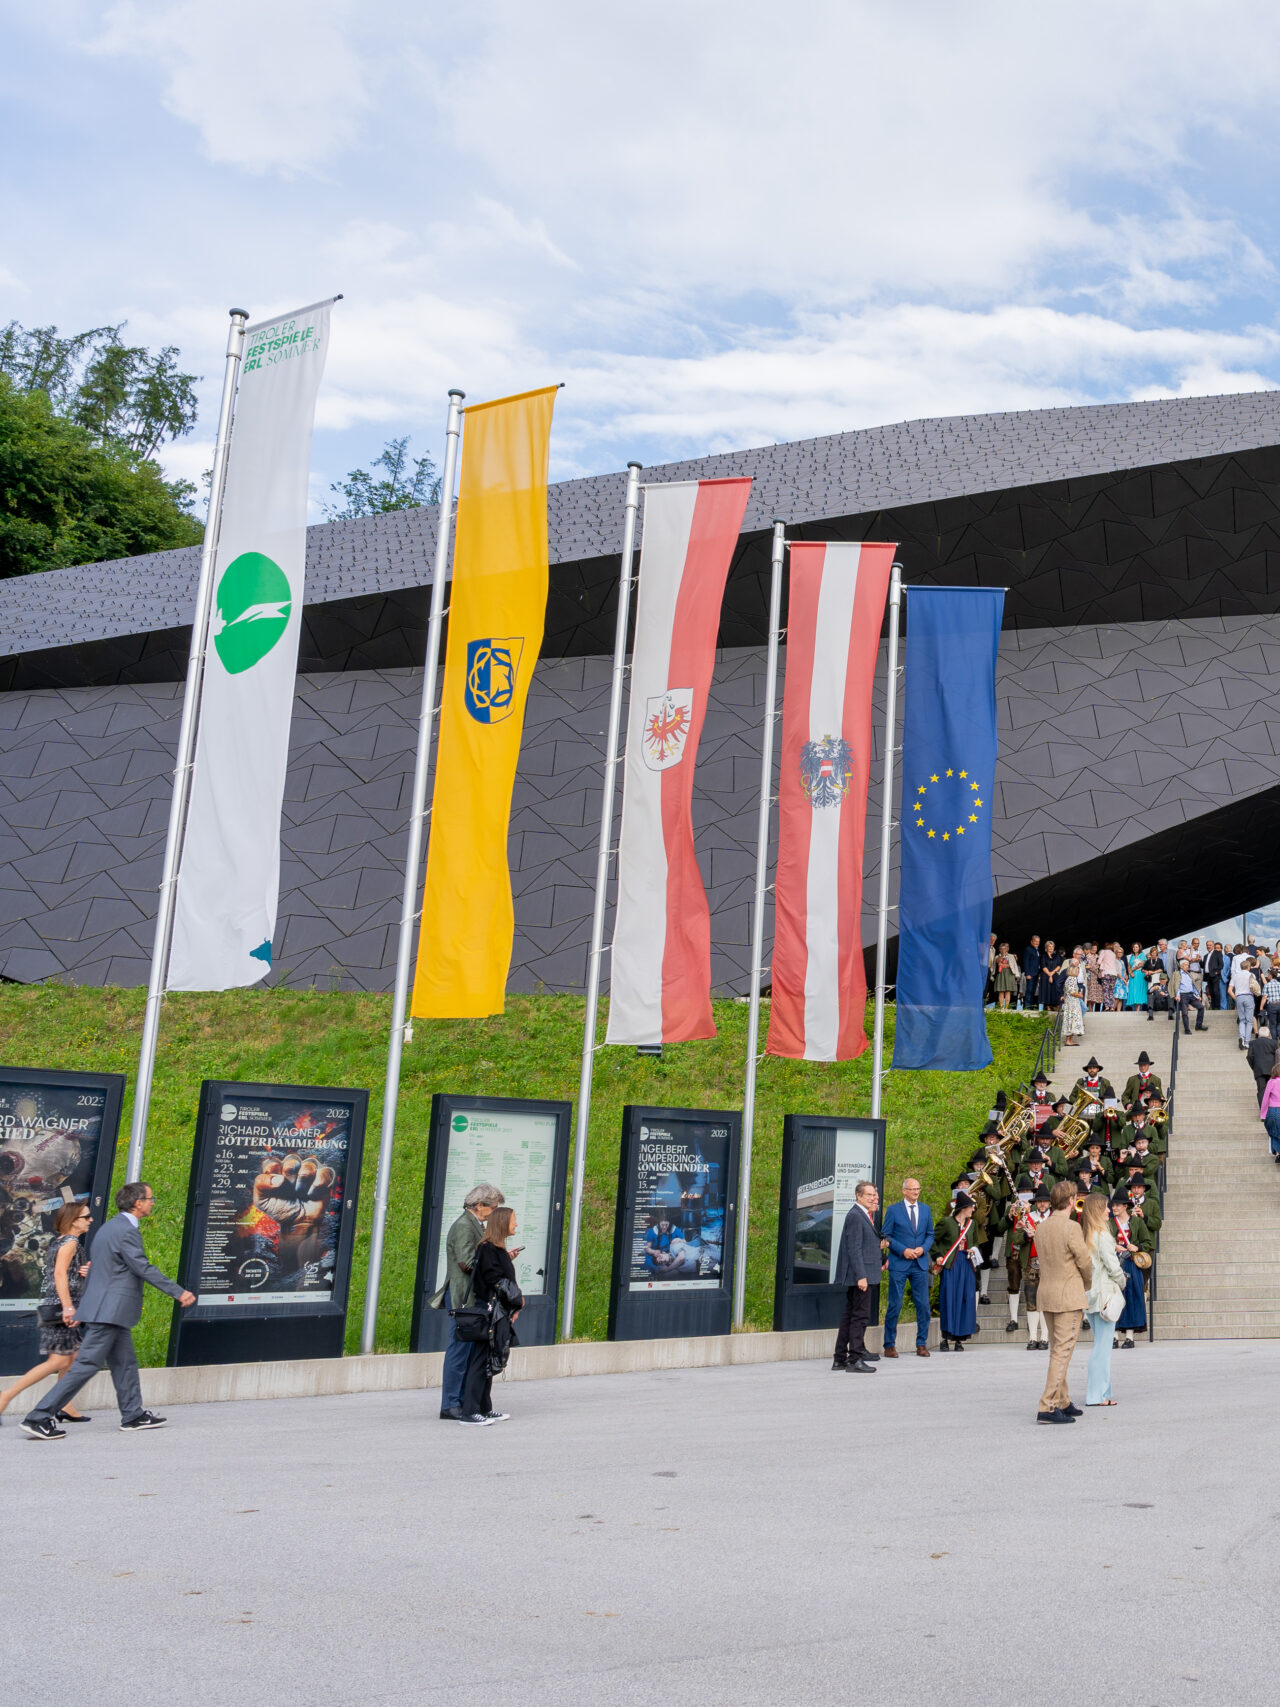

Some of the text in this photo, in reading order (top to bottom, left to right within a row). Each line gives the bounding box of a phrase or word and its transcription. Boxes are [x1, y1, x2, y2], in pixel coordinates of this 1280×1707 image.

[250, 320, 296, 345] TIROLER
[246, 326, 315, 361] FESTSPIELE
[243, 338, 320, 375] ERL SOMMER
[325, 1108, 350, 1119] 2023
[21, 1115, 89, 1130] WAGNER
[219, 1124, 321, 1138] RICHARD WAGNER
[217, 1134, 348, 1150] GÖTTERDÄMMERUNG
[640, 1144, 688, 1154] NGELBERT
